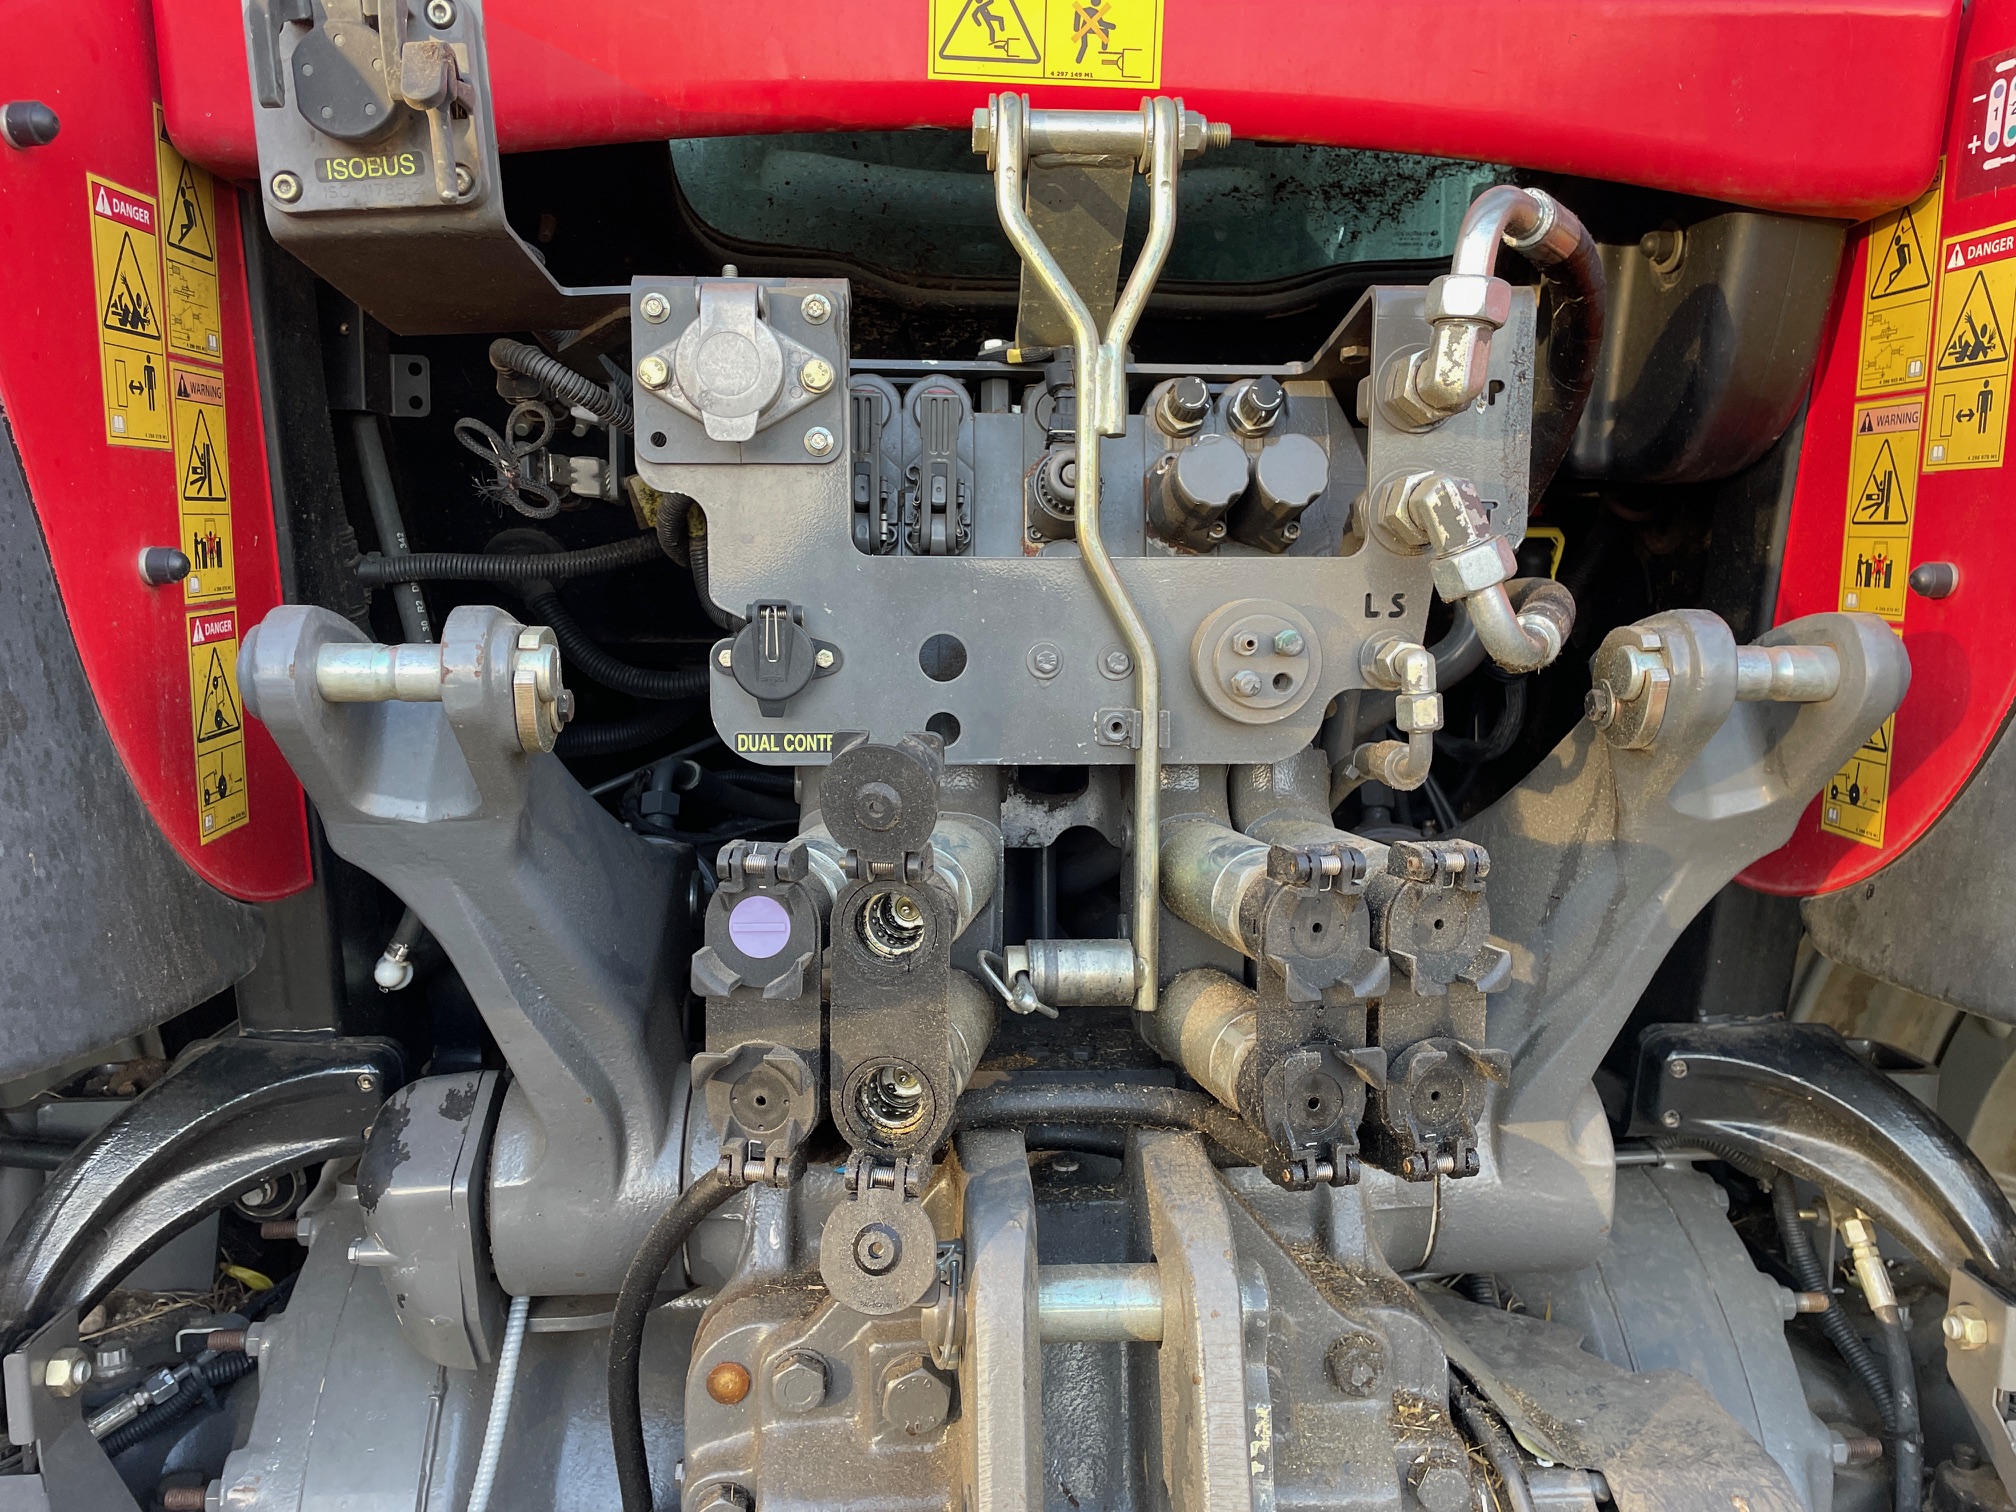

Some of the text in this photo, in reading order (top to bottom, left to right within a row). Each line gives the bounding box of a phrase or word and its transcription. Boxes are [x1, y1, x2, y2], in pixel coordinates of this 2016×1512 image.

[1993, 106, 1999, 121] 1
[326, 153, 416, 180] ISOBUS
[112, 197, 151, 225] DANGER
[1967, 236, 2015, 260] DANGER
[189, 381, 222, 399] WARNING
[1488, 379, 1506, 406] P
[1876, 411, 1919, 427] WARNING
[396, 532, 407, 549] 342
[204, 619, 233, 637] DANGER
[737, 733, 780, 752] DUAL
